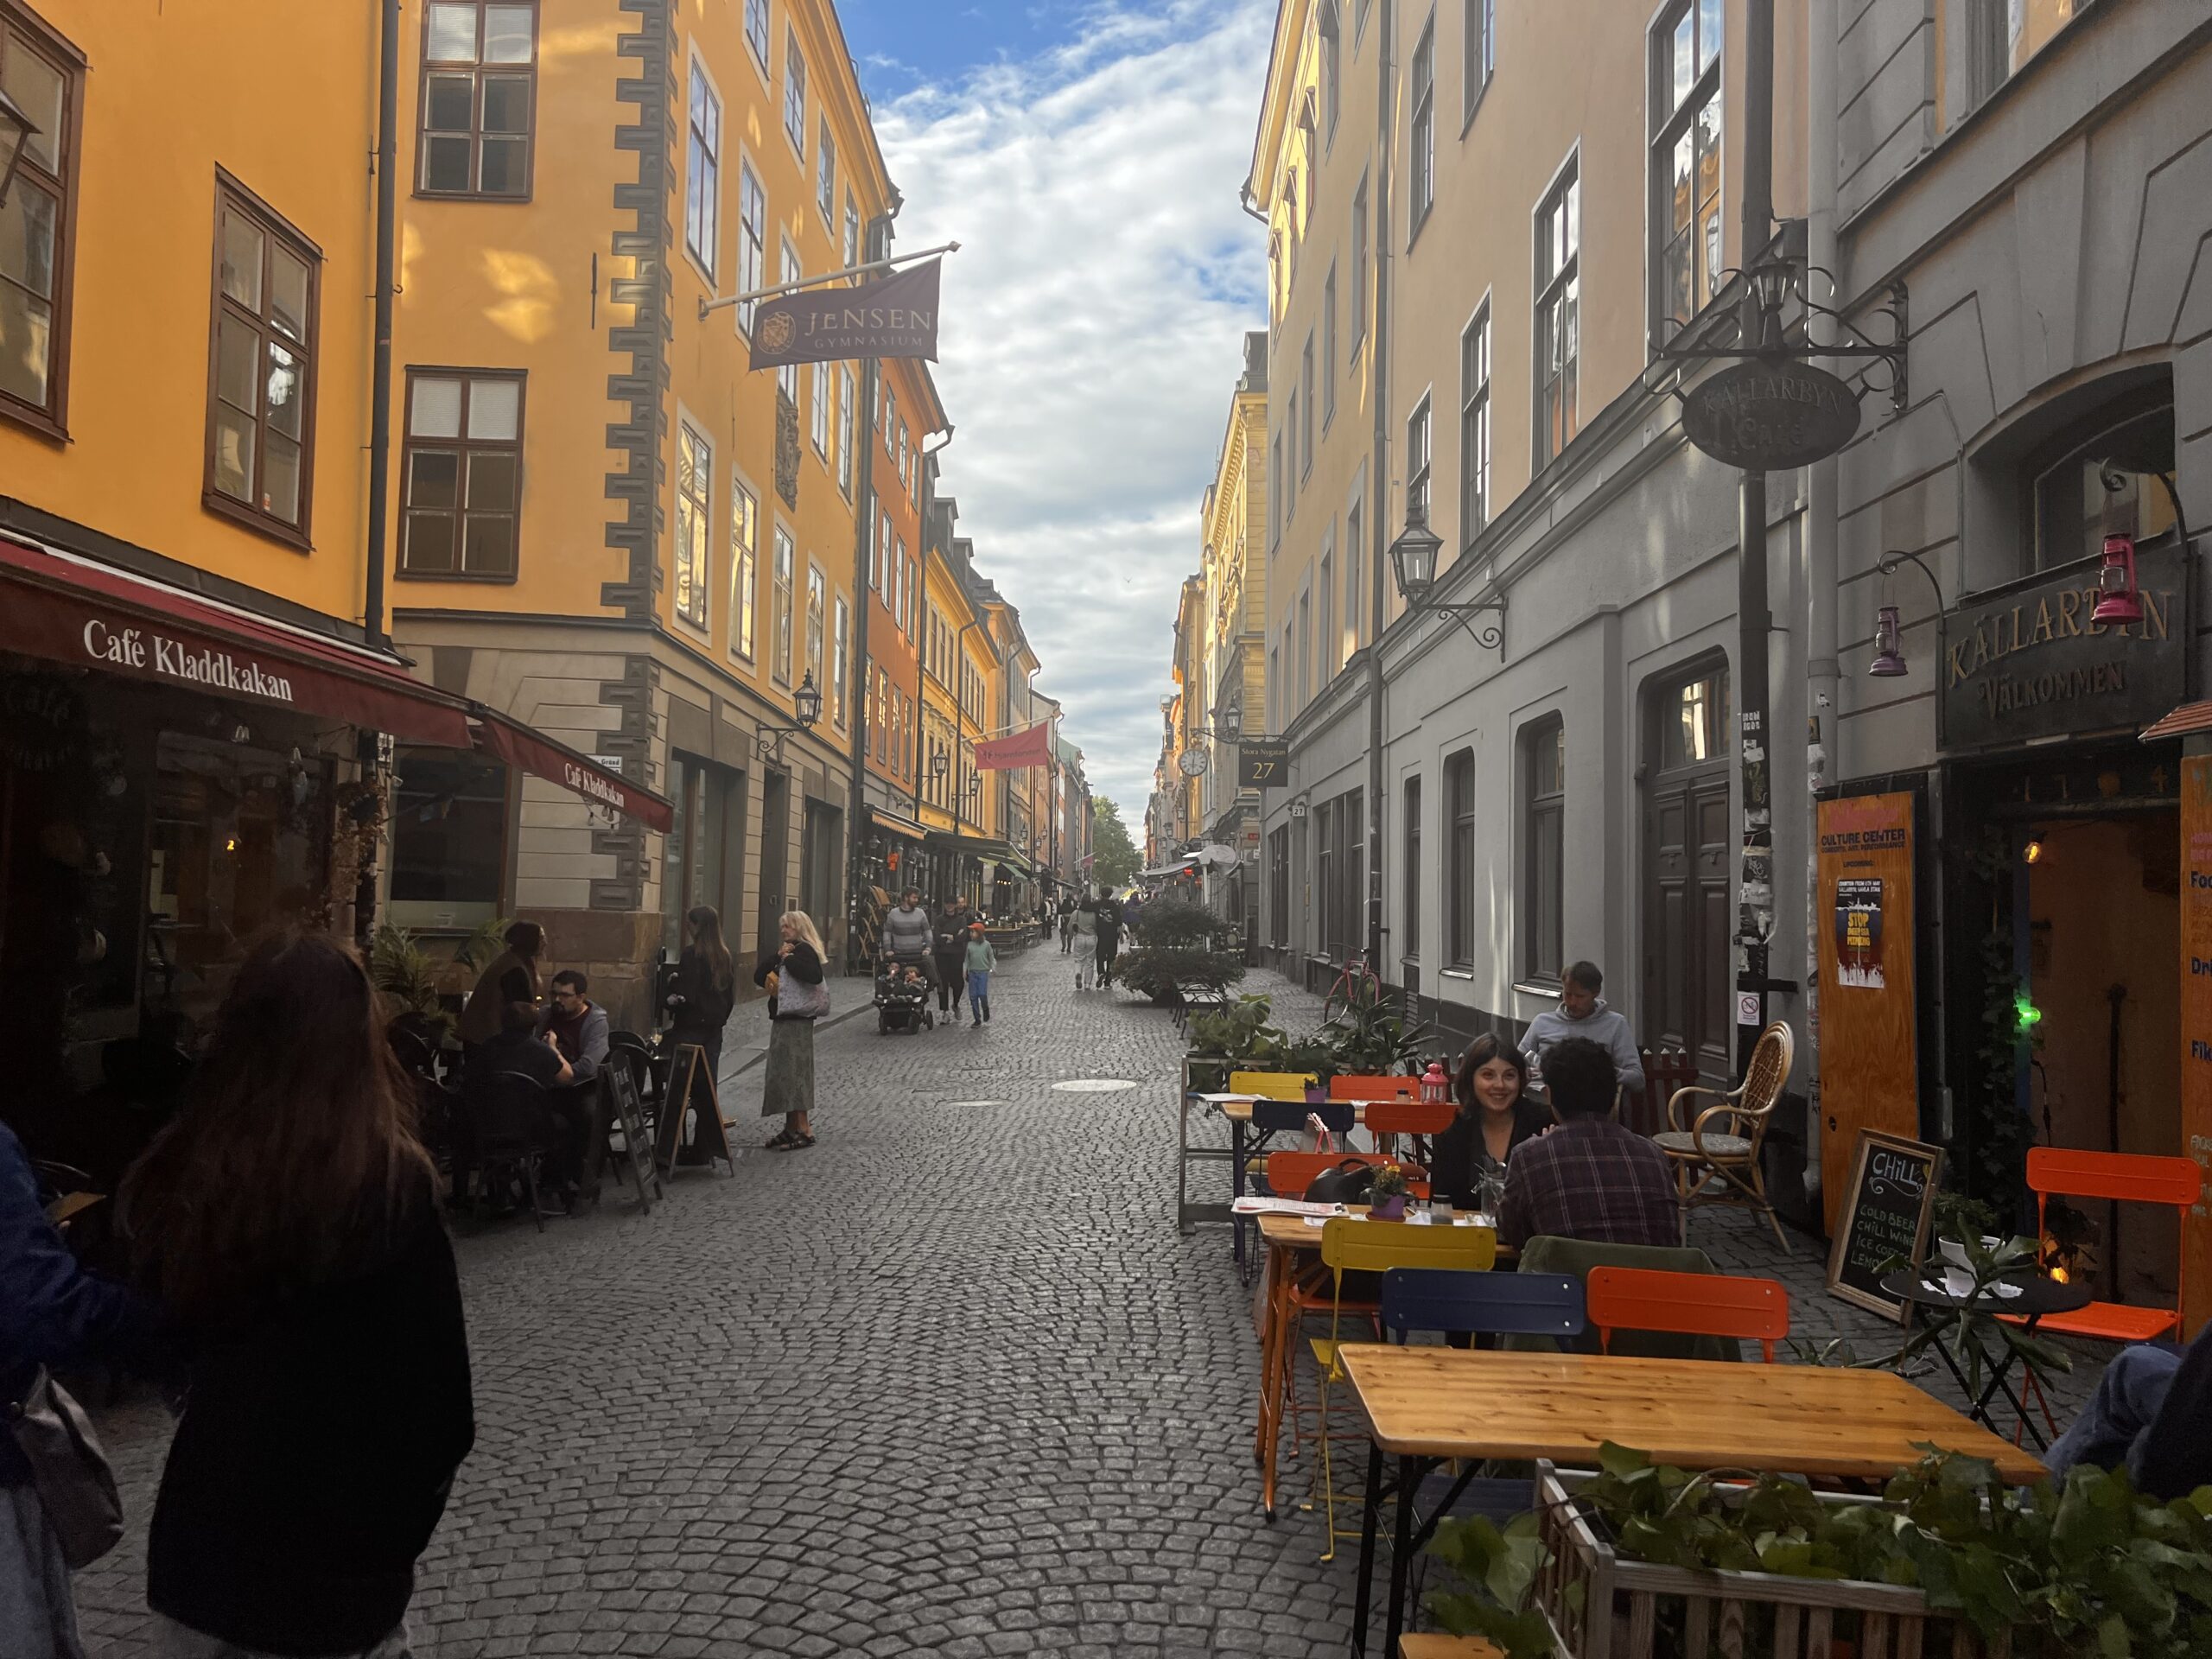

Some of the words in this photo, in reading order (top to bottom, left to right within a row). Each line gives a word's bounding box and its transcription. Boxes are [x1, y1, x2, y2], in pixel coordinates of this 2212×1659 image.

[804, 308, 931, 336] JENSEN
[815, 335, 923, 349] GYMNASIUM
[1946, 588, 2173, 689] KÄLLARBN
[83, 620, 147, 669] Café
[152, 635, 295, 702] Kladdkakan
[1976, 660, 2126, 720] VÄLKOMMEN
[1261, 748, 1286, 758] Nygatan
[565, 763, 582, 788] Café
[1252, 762, 1275, 779] 27
[1821, 832, 1860, 847] CULTURE
[1863, 829, 1905, 843] CENTER
[1848, 912, 1870, 927] STOP
[1859, 1204, 1886, 1222] COLD
[1888, 1212, 1916, 1231] BEER
[1856, 1233, 1874, 1250] ICE
